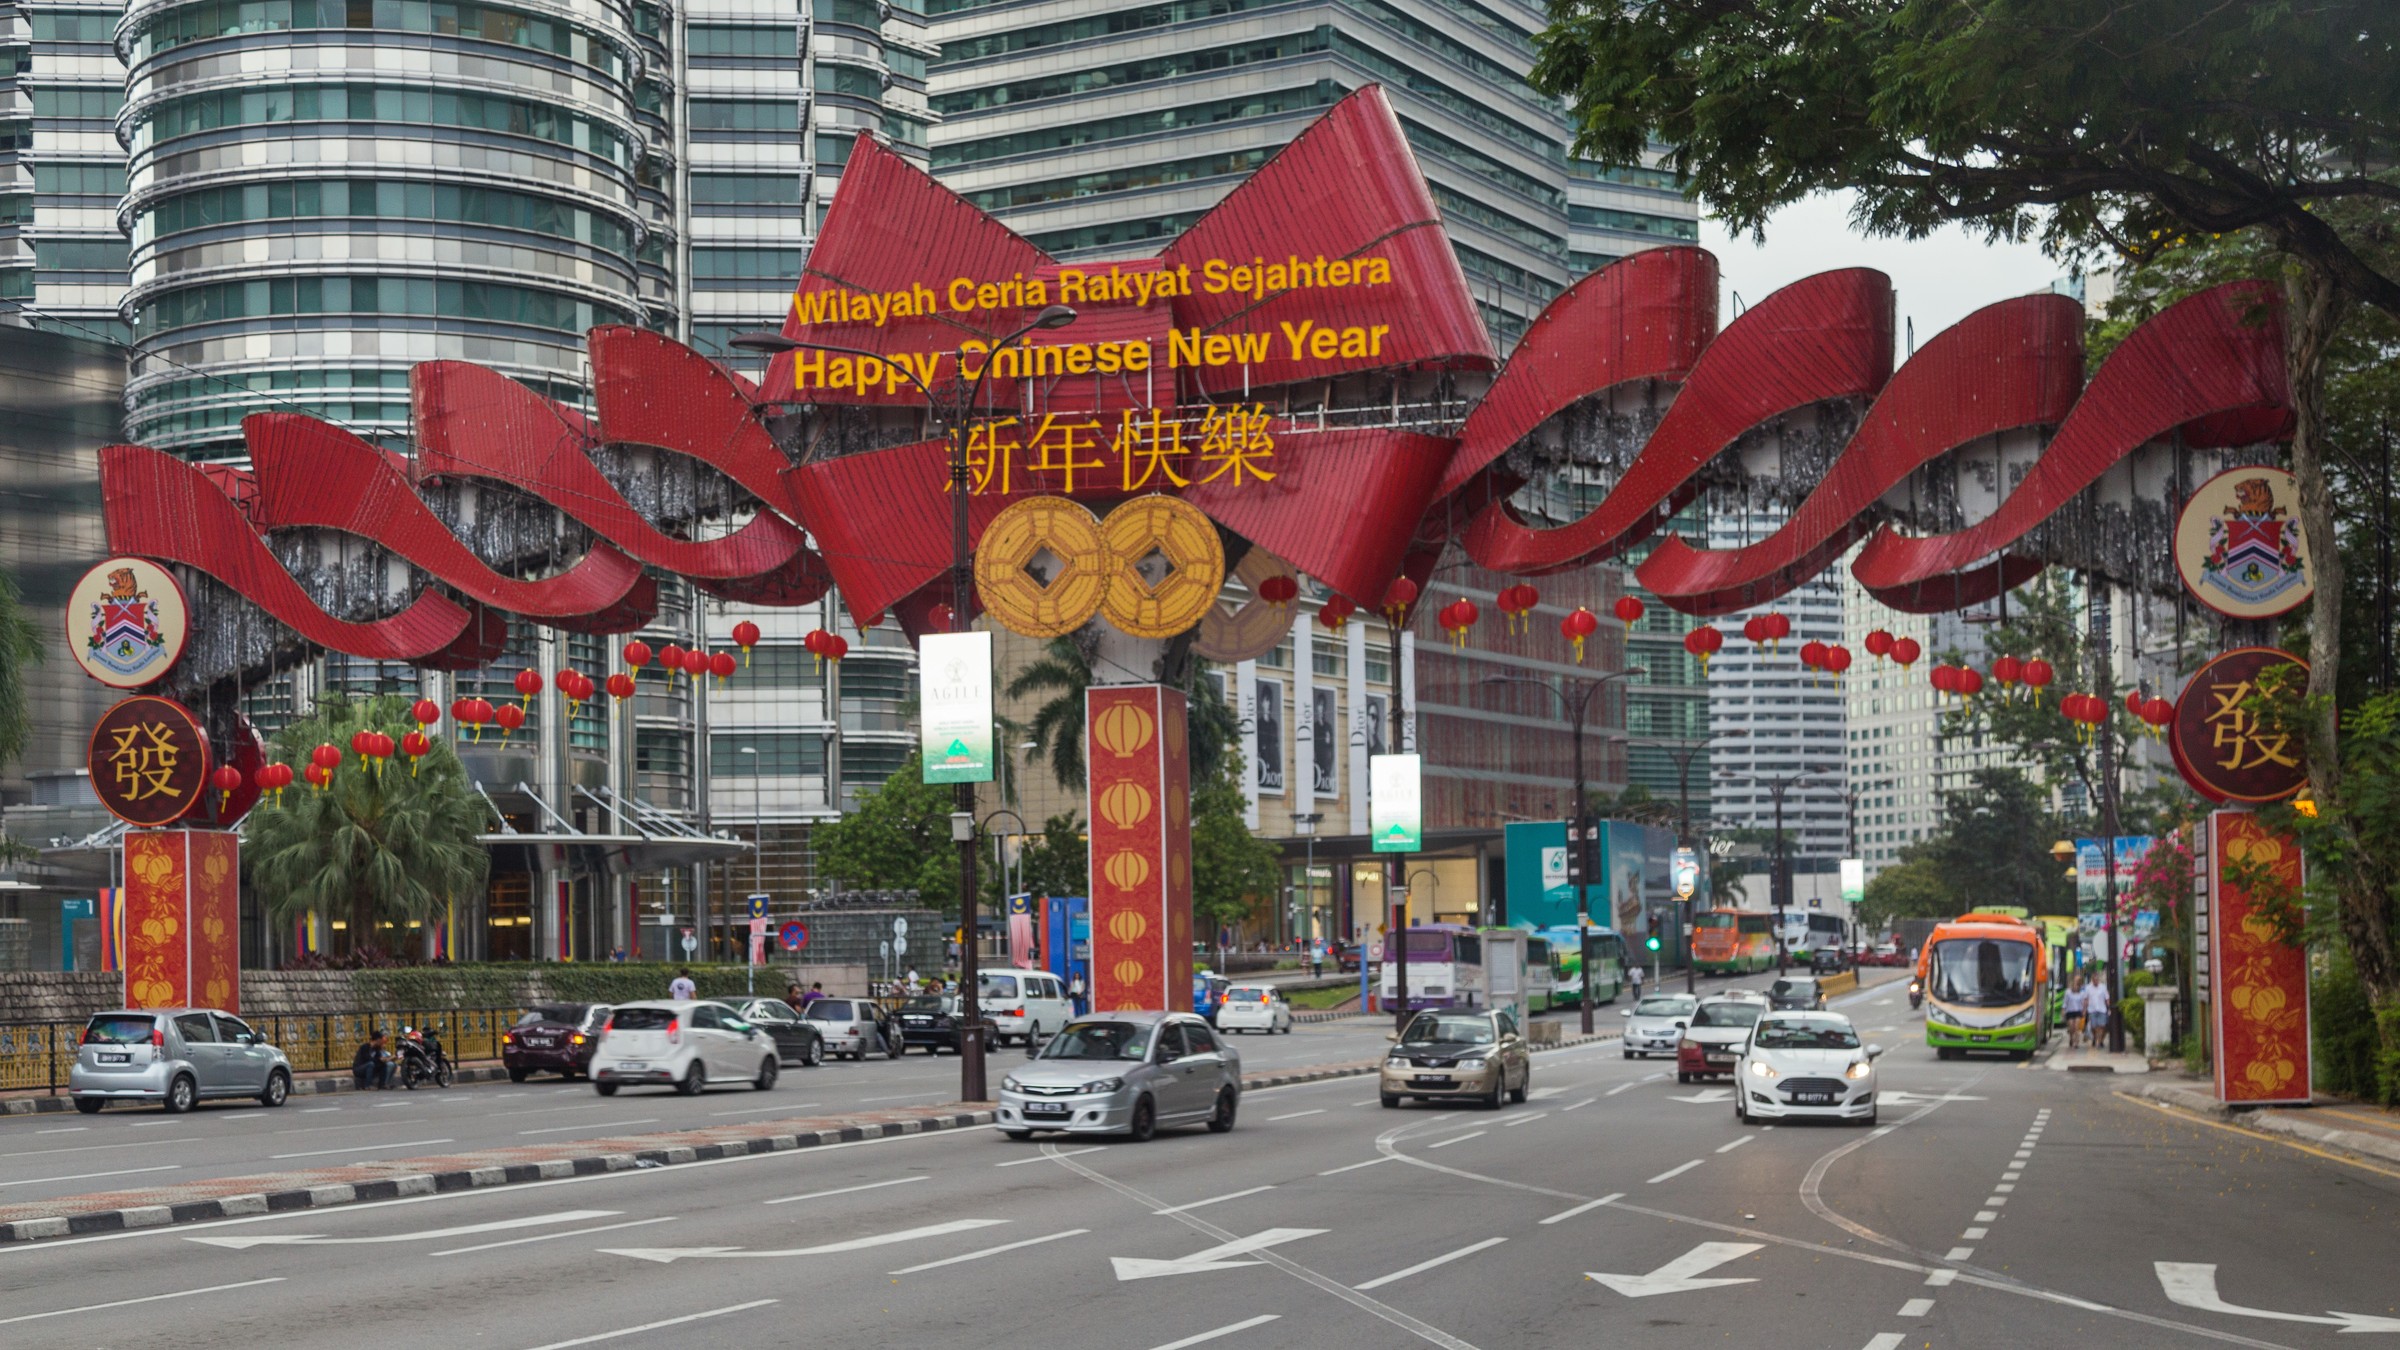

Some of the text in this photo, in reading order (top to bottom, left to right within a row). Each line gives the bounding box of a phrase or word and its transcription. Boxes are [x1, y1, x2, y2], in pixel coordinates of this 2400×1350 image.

[792, 255, 1391, 327] Wilayah Ceria Rakyat Sejahtera
[794, 319, 1389, 397] Happy Chinese New Year
[944, 402, 1277, 497] 新年快樂
[1297, 702, 1312, 742] Dior
[1350, 708, 1366, 747] Dior
[108, 721, 182, 801] 發
[87, 899, 94, 915] 1
